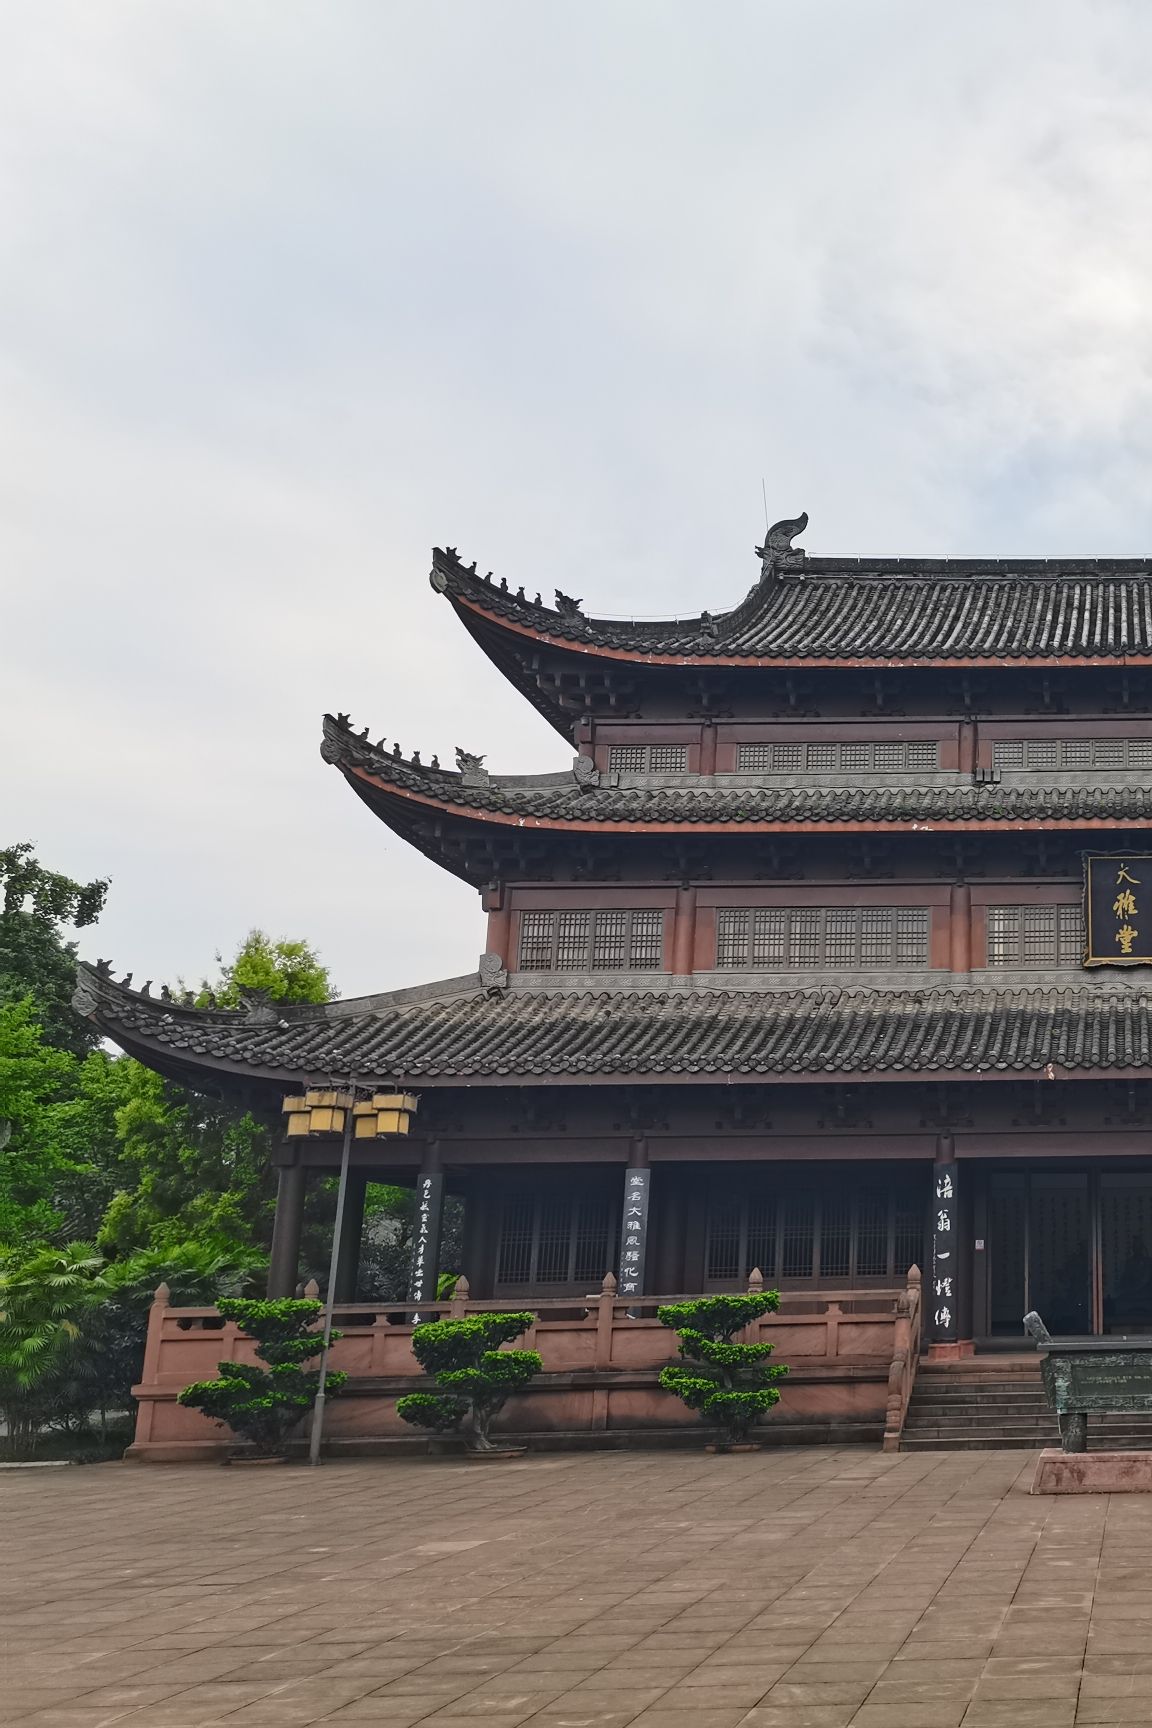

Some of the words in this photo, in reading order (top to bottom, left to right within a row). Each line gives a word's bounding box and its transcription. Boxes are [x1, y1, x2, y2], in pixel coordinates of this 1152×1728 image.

[1115, 863, 1141, 953] 大雅堂
[623, 1176, 645, 1318] 堂名大雅風騷化
